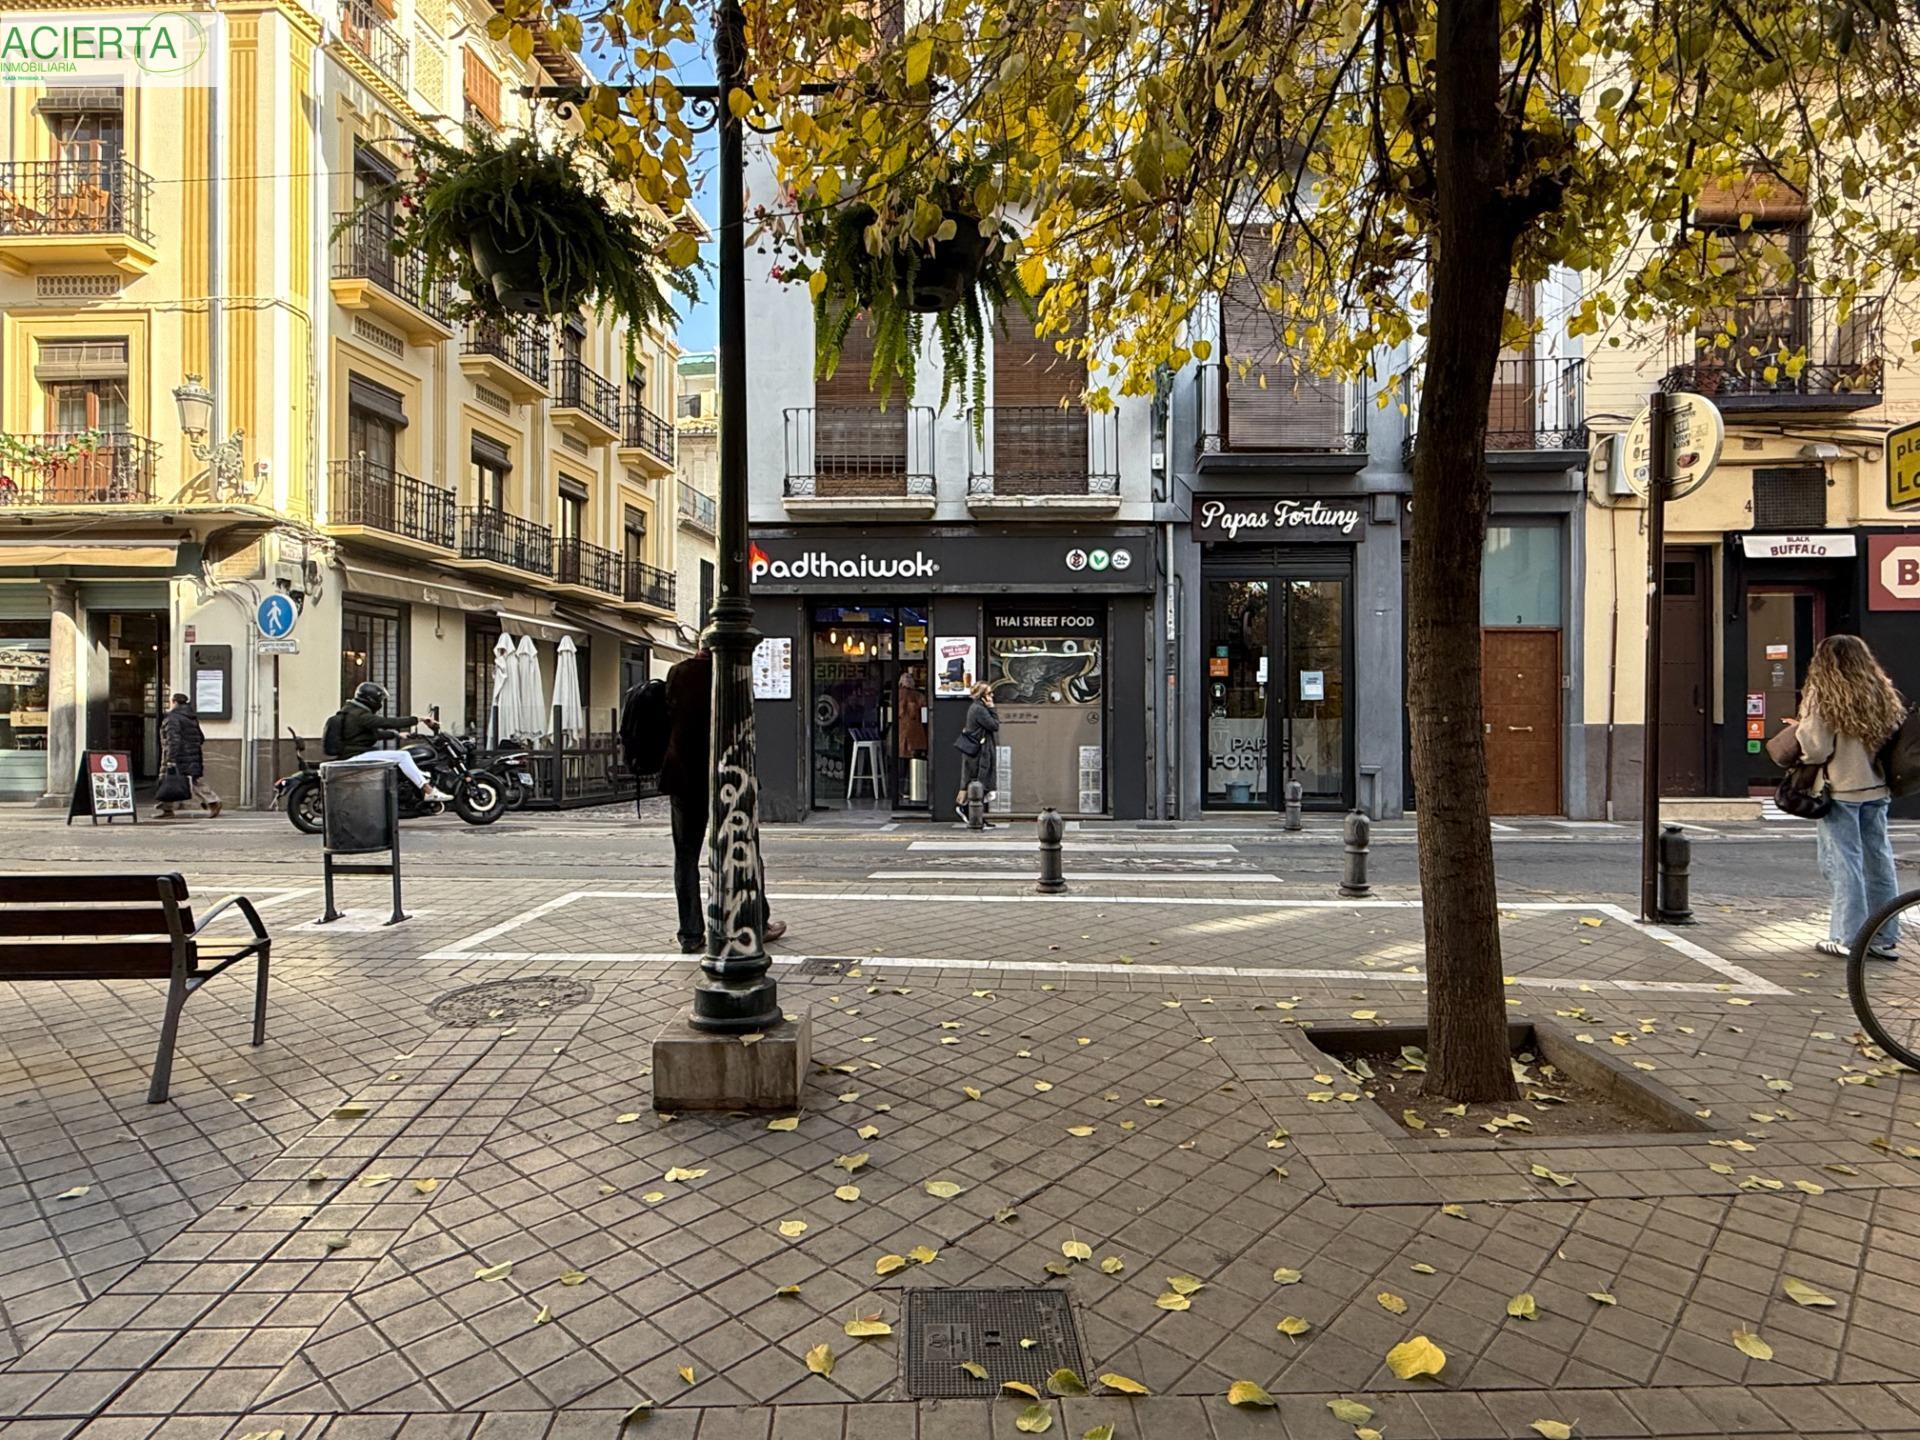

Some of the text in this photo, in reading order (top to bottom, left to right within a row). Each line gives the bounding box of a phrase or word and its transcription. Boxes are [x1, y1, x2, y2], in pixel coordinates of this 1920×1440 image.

[1744, 500, 1752, 512] 4
[1201, 501, 1359, 539] Papas Fortuny
[1770, 544, 1826, 556] BUFFALO
[995, 616, 1095, 627] THAI STREET FOOD
[1231, 738, 1290, 752] PAPS
